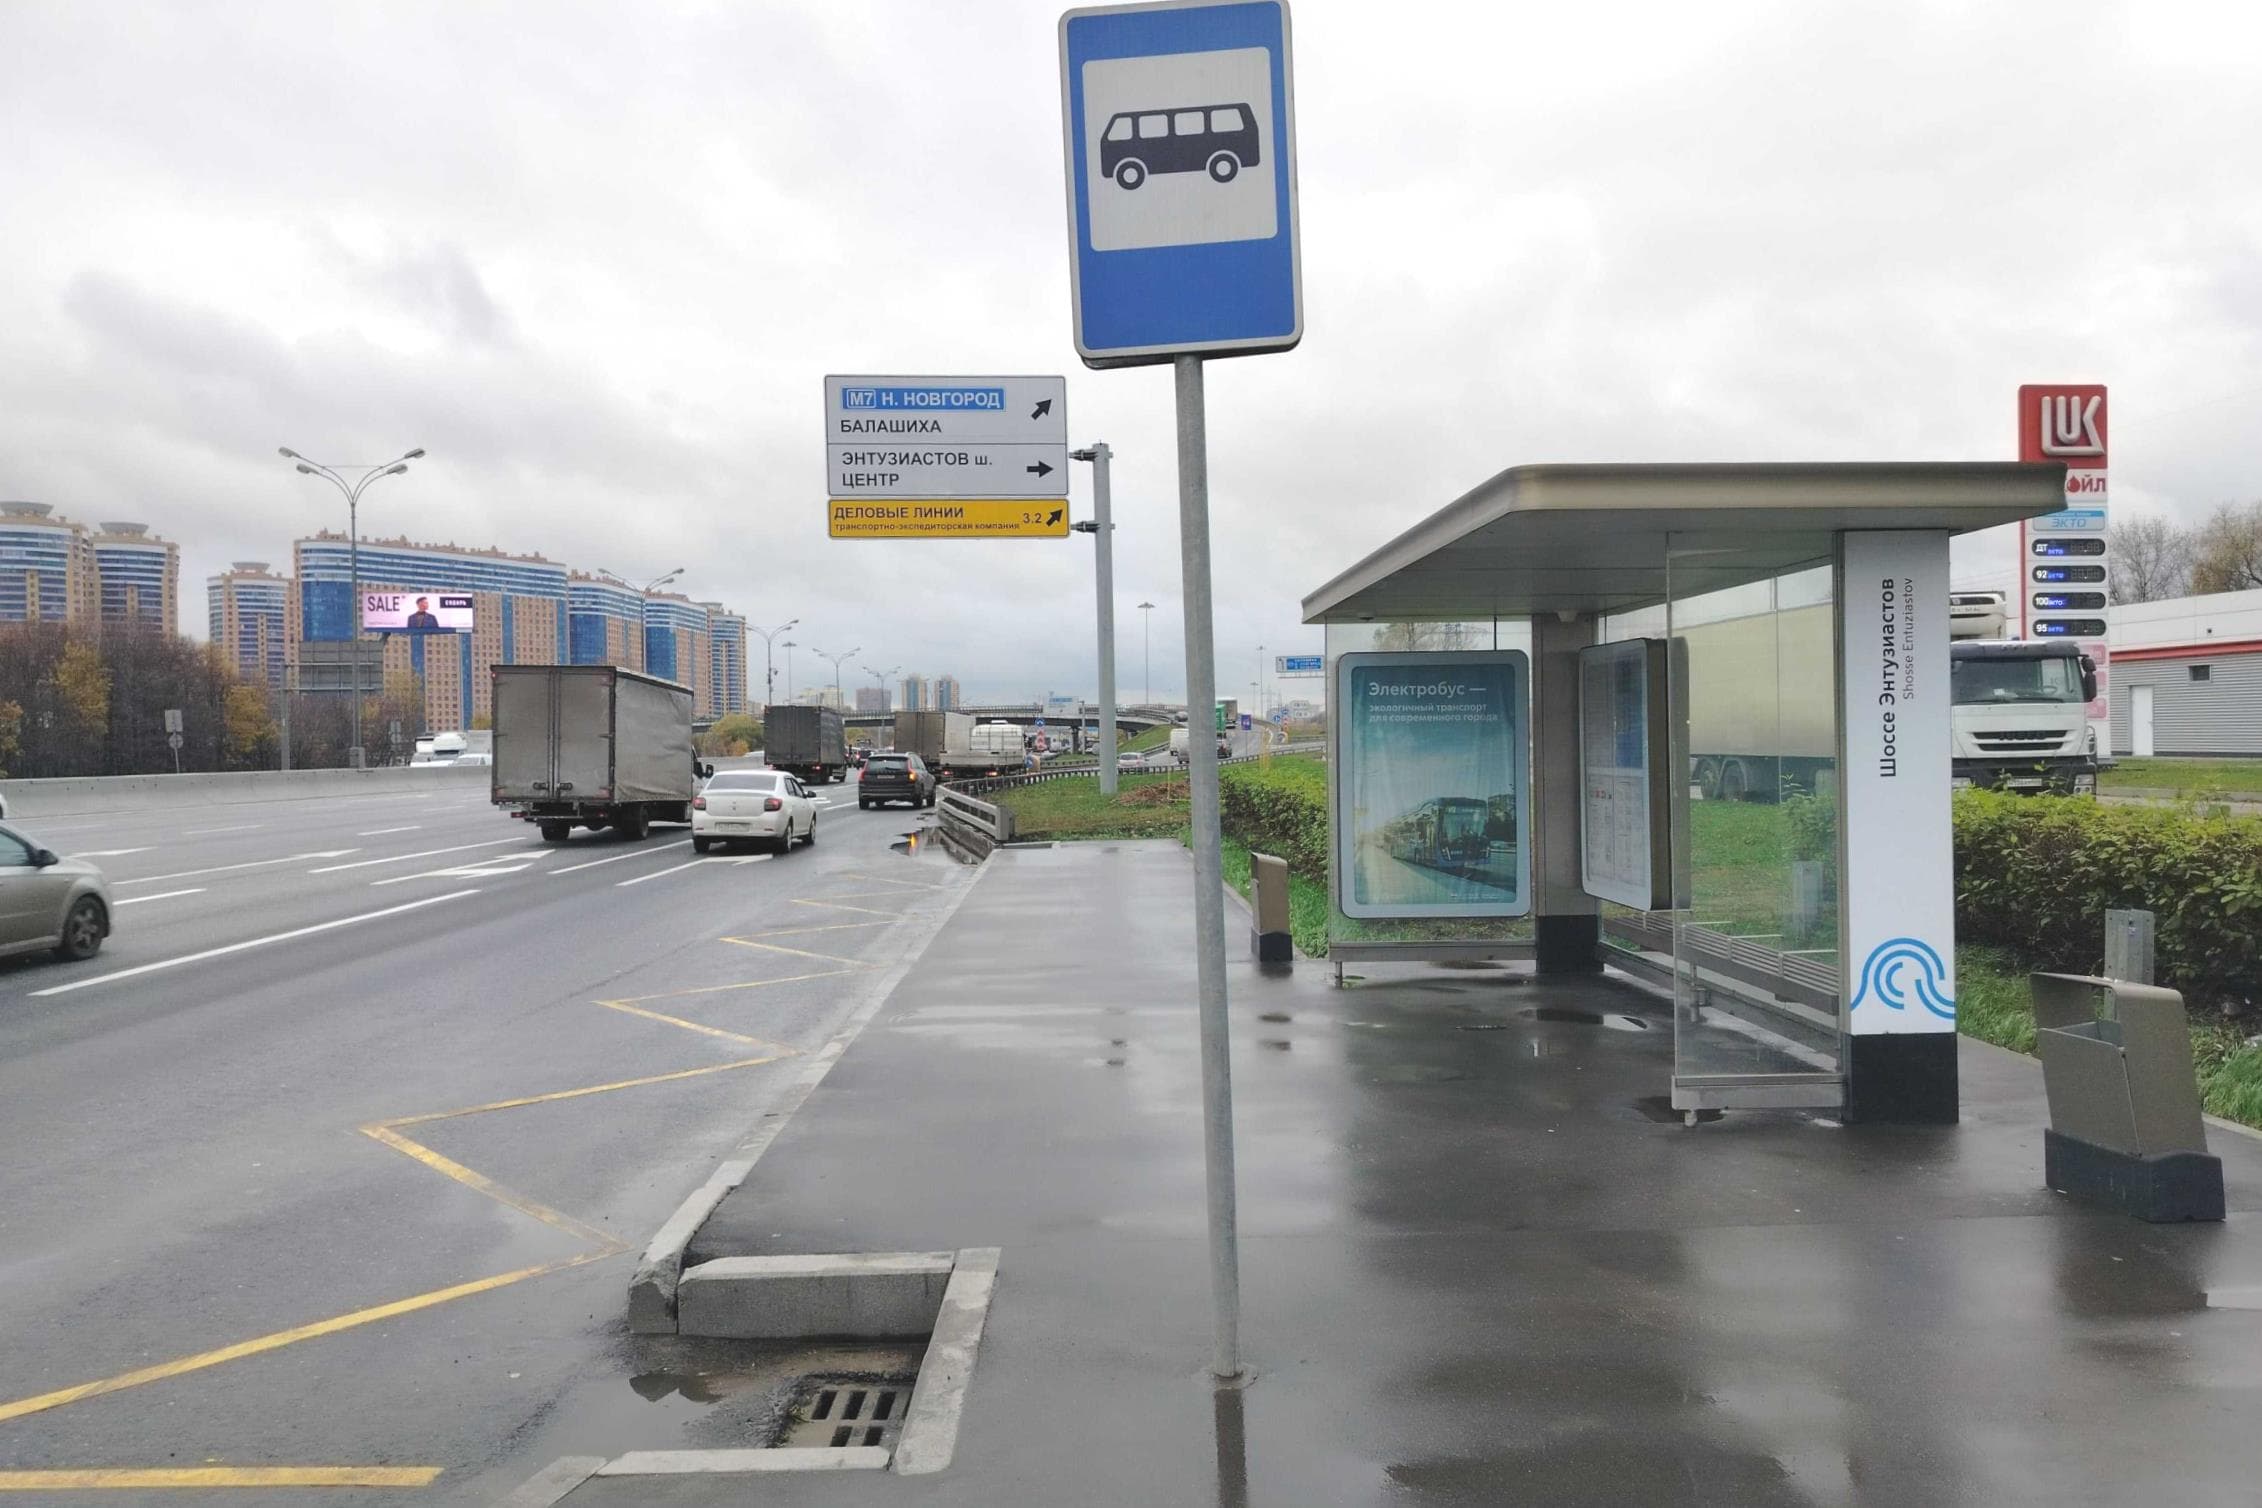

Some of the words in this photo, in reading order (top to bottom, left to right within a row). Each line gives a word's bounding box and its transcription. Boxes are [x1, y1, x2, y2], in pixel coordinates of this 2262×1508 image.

[850, 391, 873, 406] М7
[882, 391, 898, 406] Н.
[903, 391, 1001, 409] НОВГОРОД
[840, 419, 942, 433] БАЛАШИХА
[842, 451, 969, 466] ЭНТУЗИАСТОВ
[975, 455, 993, 466] ш.
[842, 473, 900, 489] ЦЕНТР
[834, 506, 909, 520] ДЕЛОВЫЕ
[913, 506, 963, 518] ЛИНИИ
[1023, 512, 1042, 524] 3.2
[975, 523, 1020, 531] компания
[2051, 518, 2087, 528] ЭКТО
[2035, 543, 2048, 553] ДТ
[2036, 569, 2047, 579] 92
[367, 595, 401, 612] SALE
[2035, 597, 2048, 606] 100
[1902, 578, 1914, 651] Entuziastov
[2036, 623, 2047, 633] 95
[1879, 578, 1899, 706] Энтузиастов
[1902, 655, 1914, 700] Shosse
[1368, 681, 1465, 698] Электробус
[1369, 703, 1434, 713] экологичный
[1436, 703, 1487, 713] транспорт
[1369, 714, 1388, 723] для
[1389, 713, 1462, 723] современного
[1463, 713, 1498, 722] города
[1879, 711, 1897, 777] Шоссе
